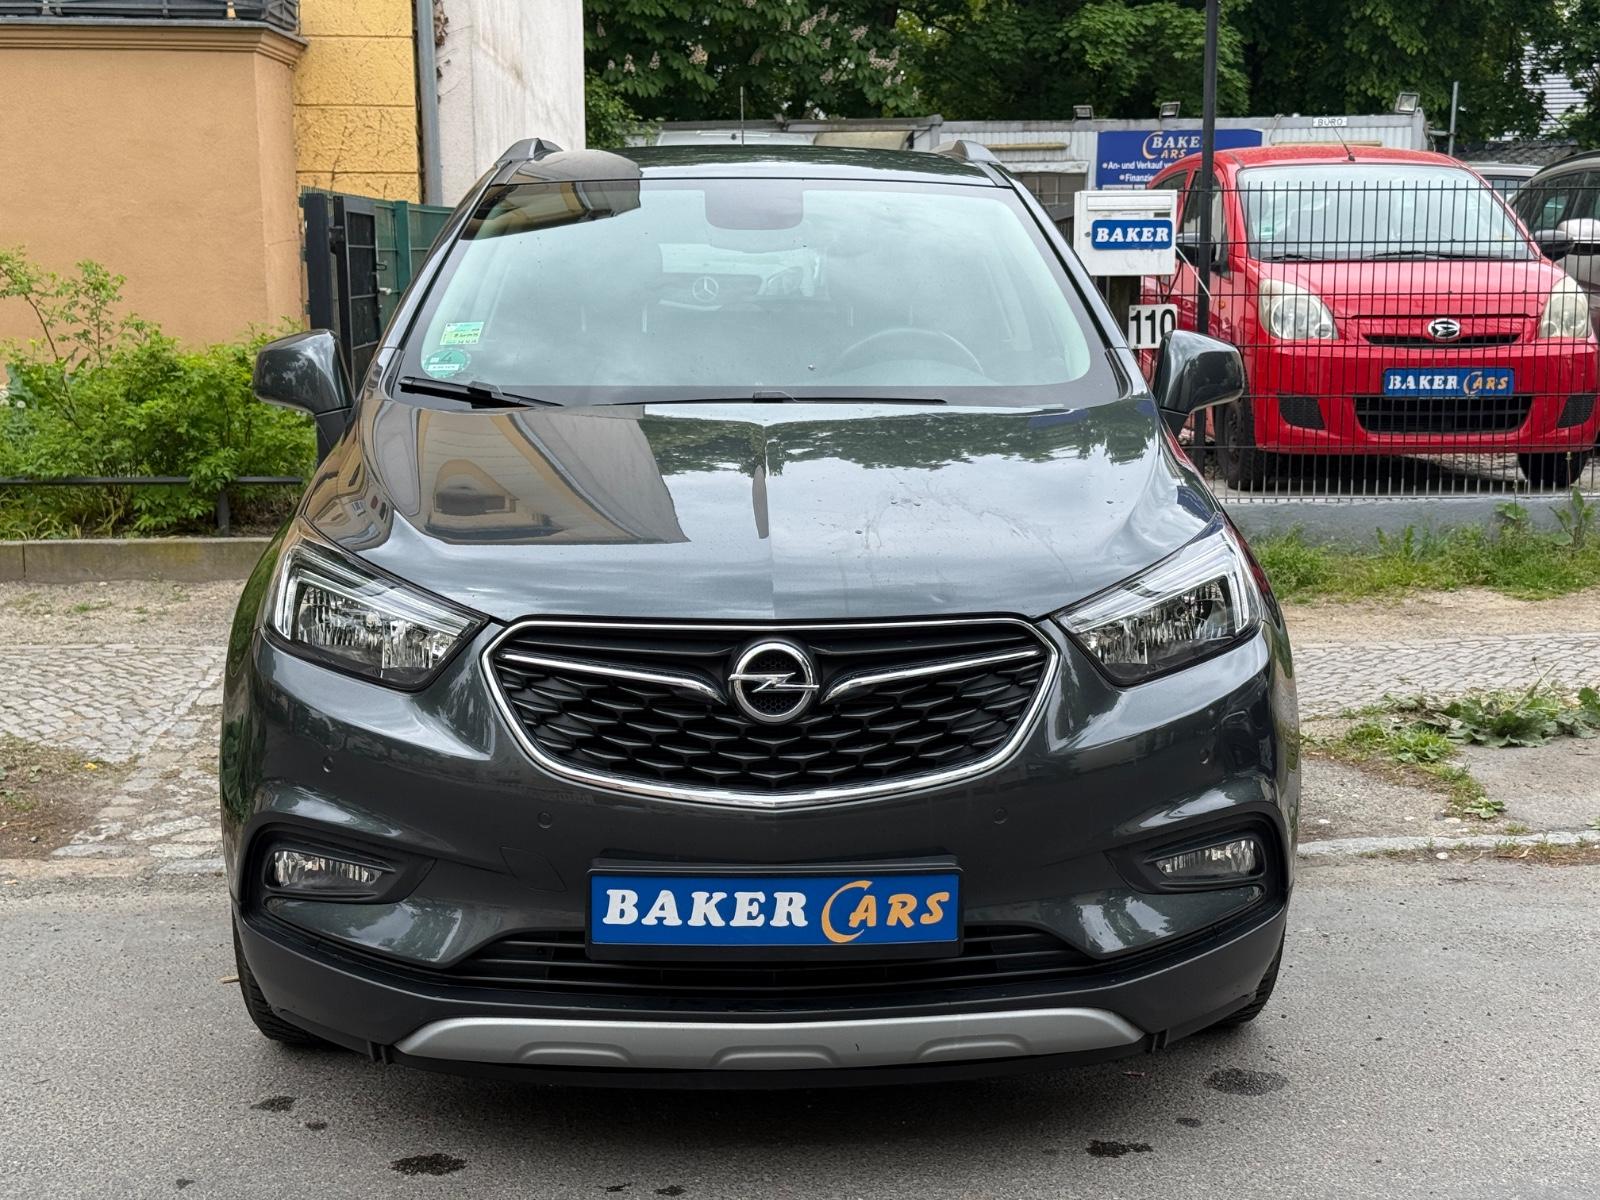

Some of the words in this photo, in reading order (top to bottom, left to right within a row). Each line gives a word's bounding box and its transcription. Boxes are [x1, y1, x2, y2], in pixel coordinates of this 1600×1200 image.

[1151, 136, 1201, 149] BAKE
[1107, 162, 1120, 170] An-
[1121, 161, 1135, 170] und
[1136, 160, 1163, 170] Verkauf
[1095, 227, 1169, 243] BAKER
[1130, 309, 1176, 345] 110
[1388, 375, 1460, 390] BAKER
[1463, 371, 1509, 395] CARS
[602, 888, 809, 927] BAKER
[821, 880, 950, 943] CARS
